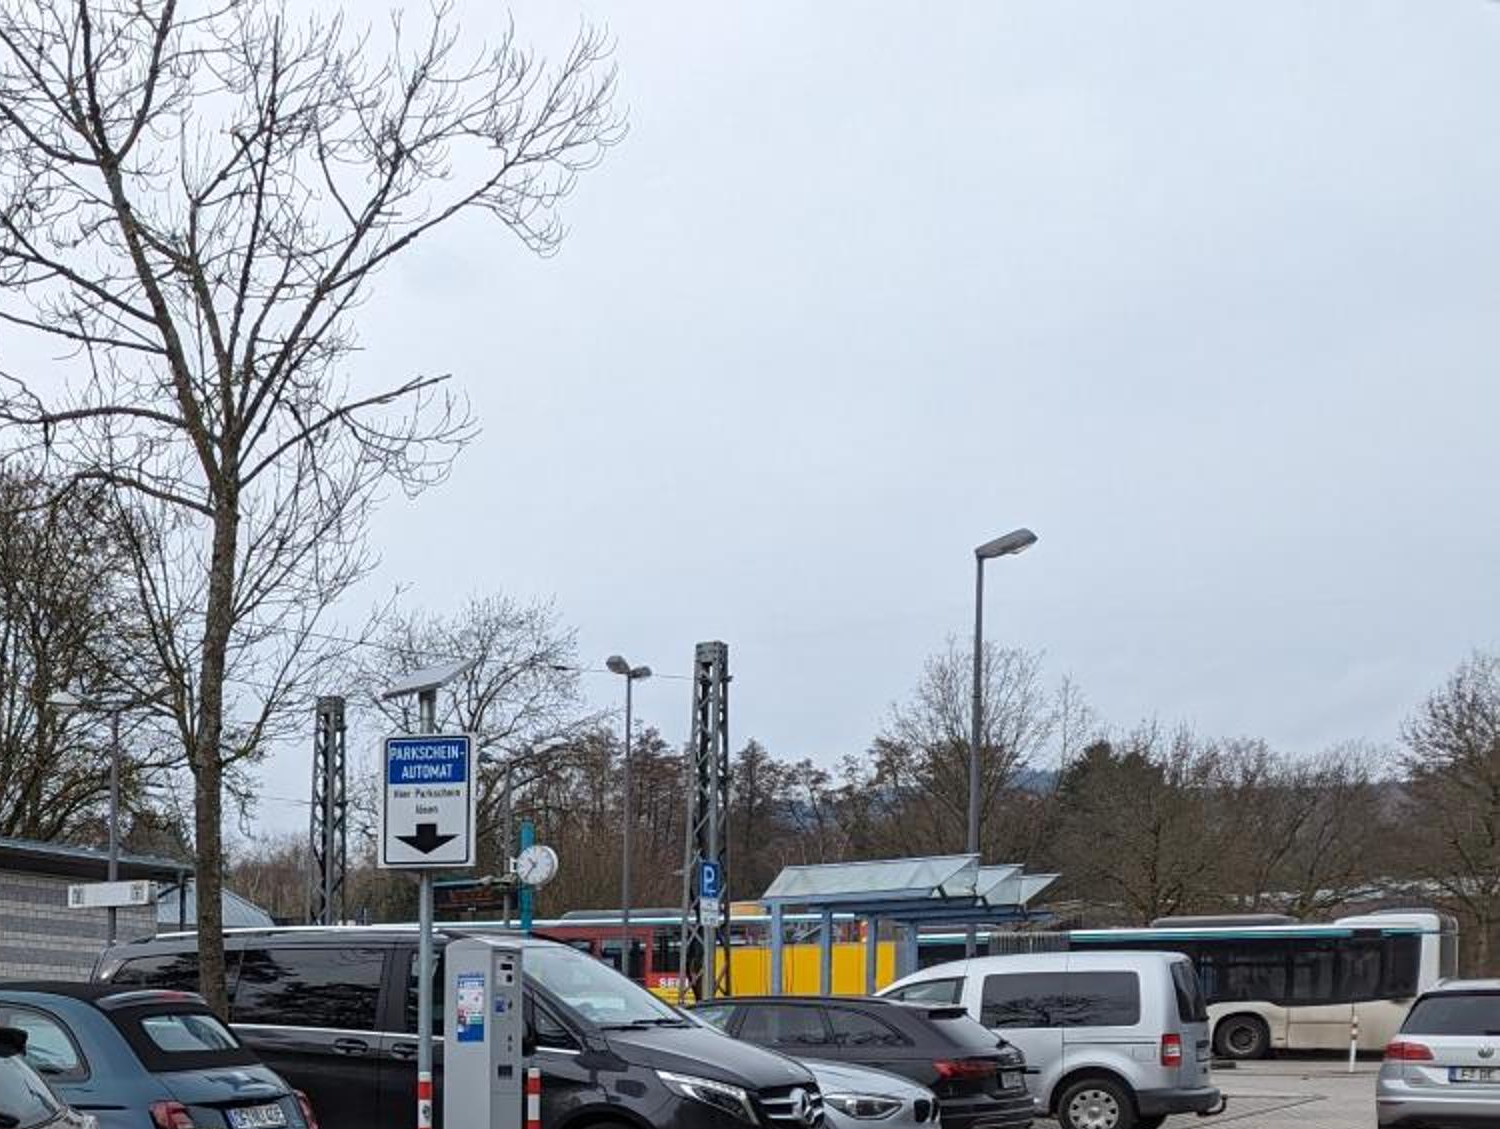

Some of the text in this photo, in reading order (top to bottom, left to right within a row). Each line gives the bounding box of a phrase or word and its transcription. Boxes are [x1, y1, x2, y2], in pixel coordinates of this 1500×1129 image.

[389, 744, 465, 761] PARKSCHEIN-
[401, 763, 453, 780] AUTOMAT
[703, 865, 715, 893] P
